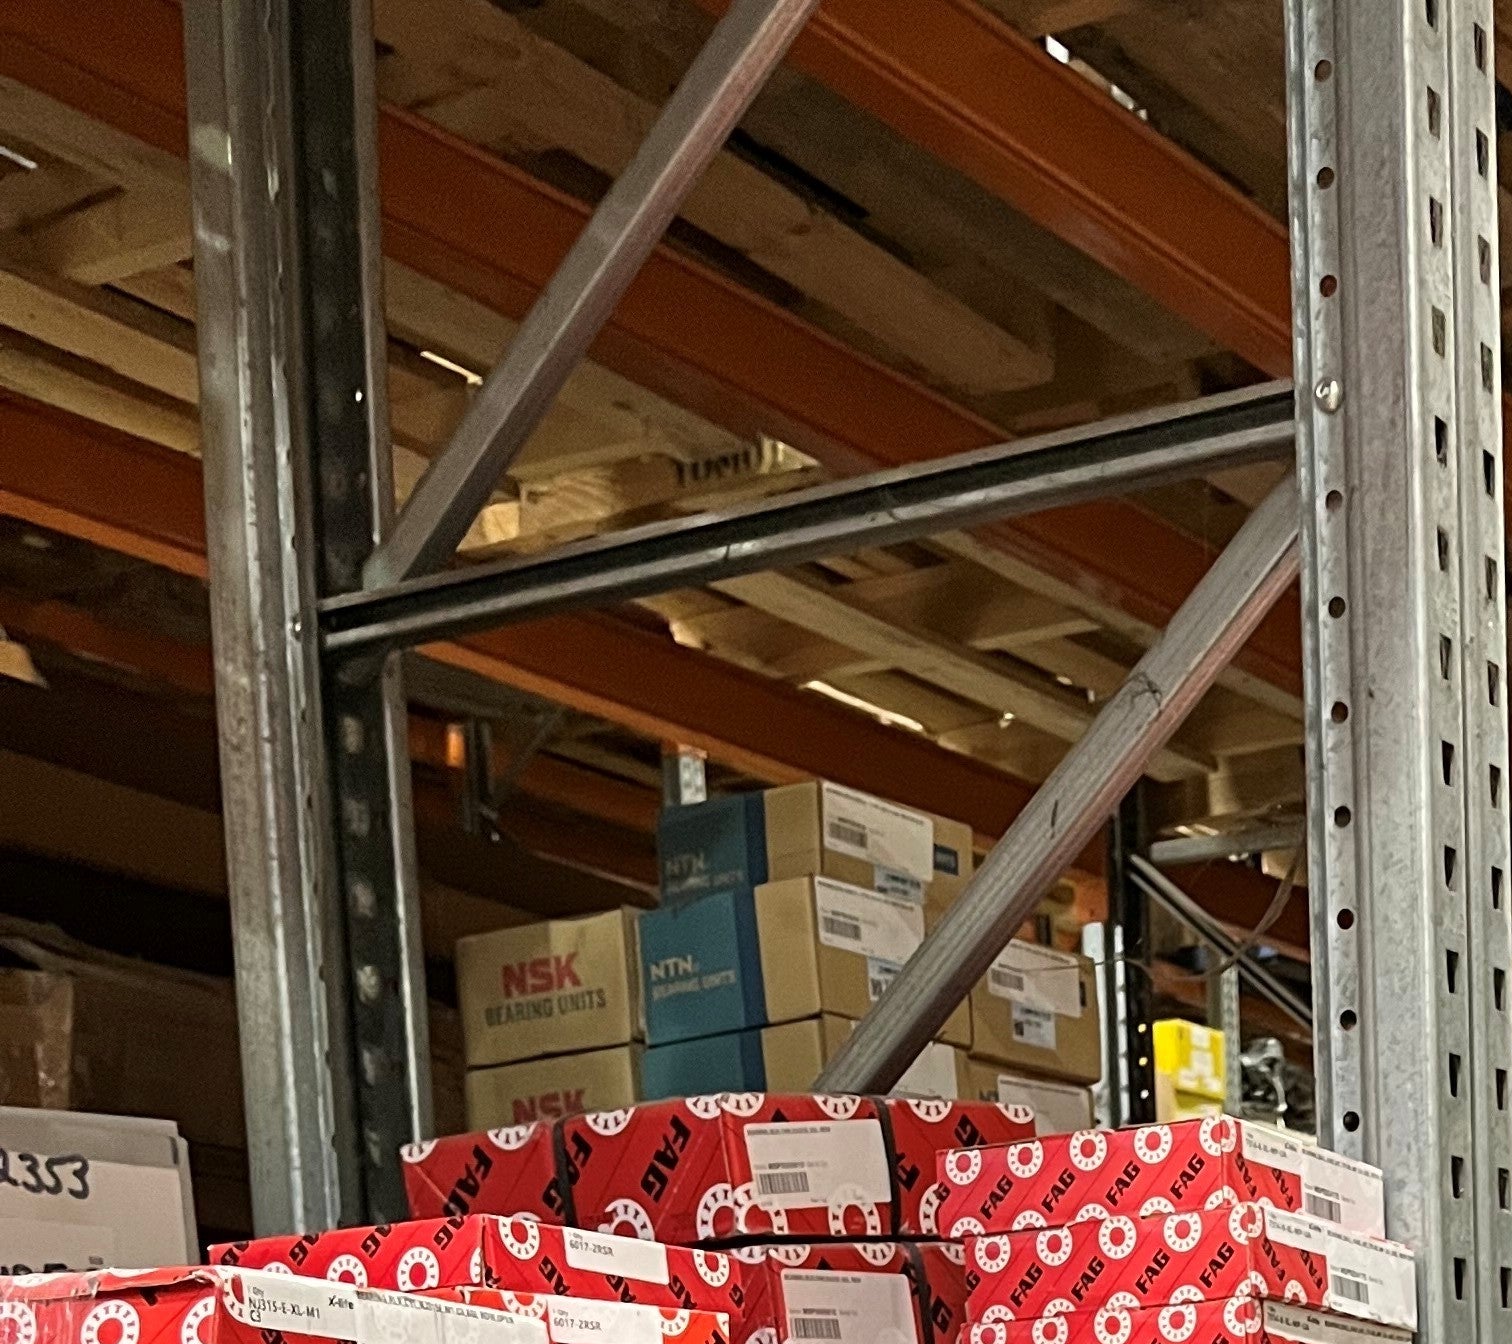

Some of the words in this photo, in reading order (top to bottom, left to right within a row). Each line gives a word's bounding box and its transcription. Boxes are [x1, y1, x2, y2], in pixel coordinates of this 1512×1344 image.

[502, 951, 581, 998] NSK
[650, 955, 693, 981] NTN
[485, 998, 553, 1027] BEARING
[557, 988, 606, 1016] UNITS
[641, 1115, 691, 1204] FAG
[1169, 1152, 1205, 1200] FAG
[979, 1174, 1013, 1220] FAG
[1041, 1167, 1076, 1212] FAG
[1105, 1160, 1140, 1206] FAG
[539, 1255, 570, 1296] AG
[1009, 1262, 1043, 1307] FAG
[1070, 1255, 1105, 1302] FAG
[1135, 1247, 1170, 1294] FAG
[1199, 1241, 1234, 1288] FAG
[669, 1274, 697, 1309] AG
